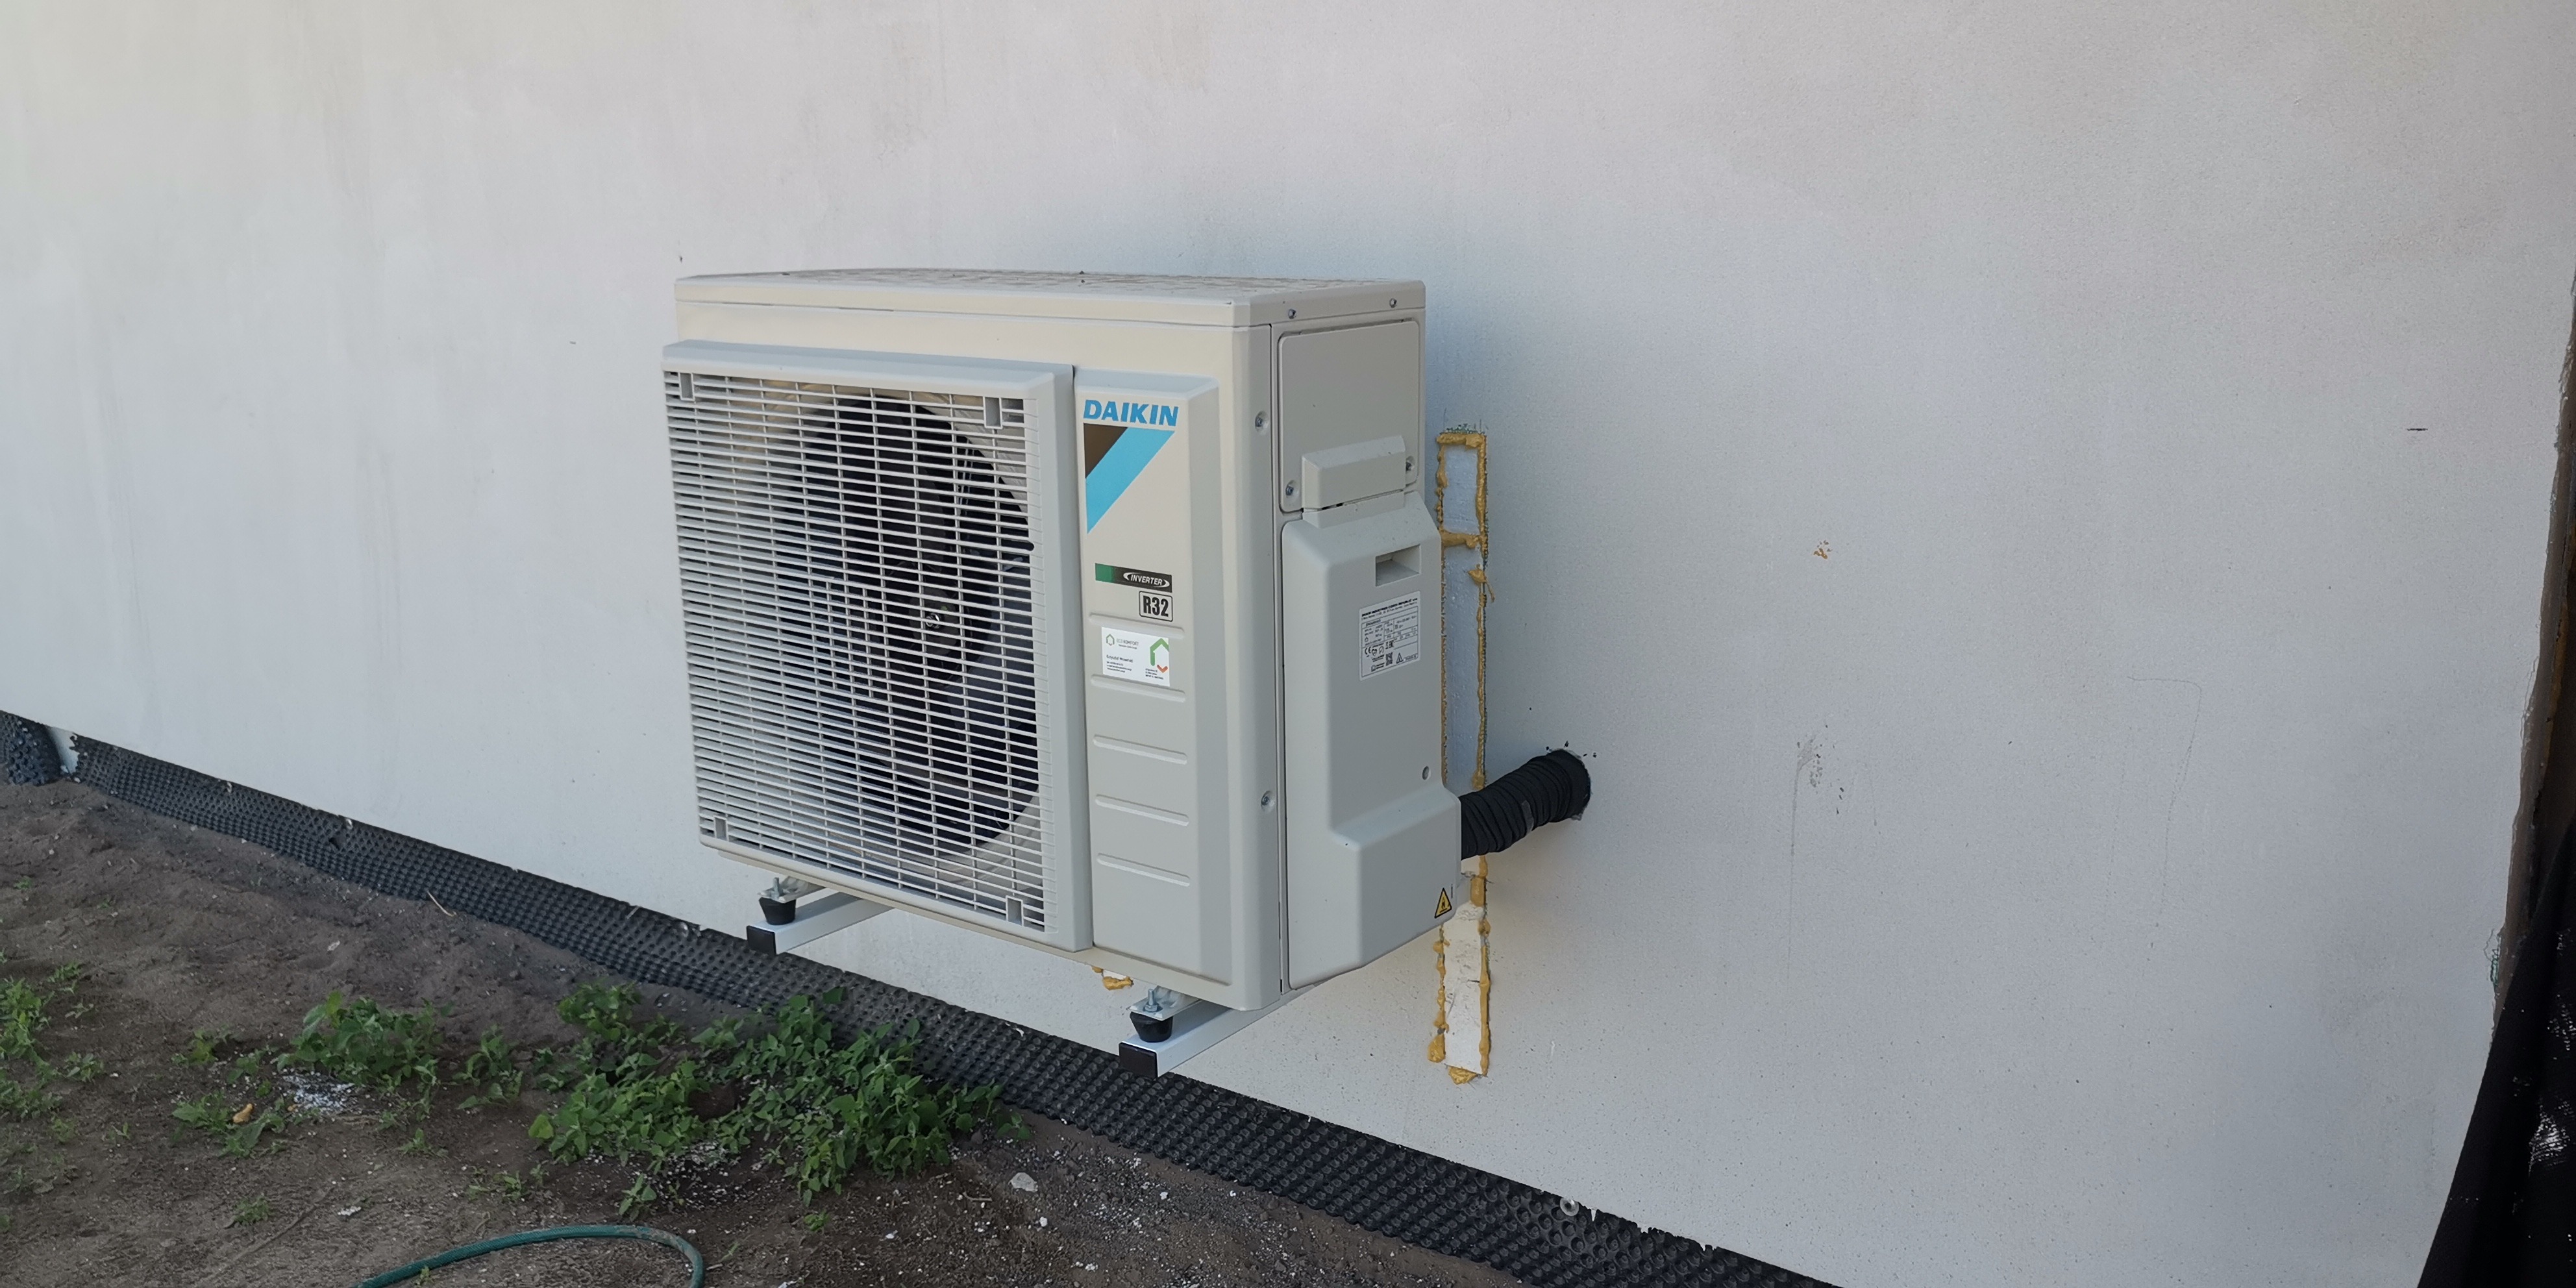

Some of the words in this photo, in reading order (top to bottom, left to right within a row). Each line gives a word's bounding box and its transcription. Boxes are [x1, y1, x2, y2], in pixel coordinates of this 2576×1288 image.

[1084, 399, 1178, 427] DAIKIN
[1130, 575, 1163, 586] INVERTER
[1143, 595, 1169, 617] R32
